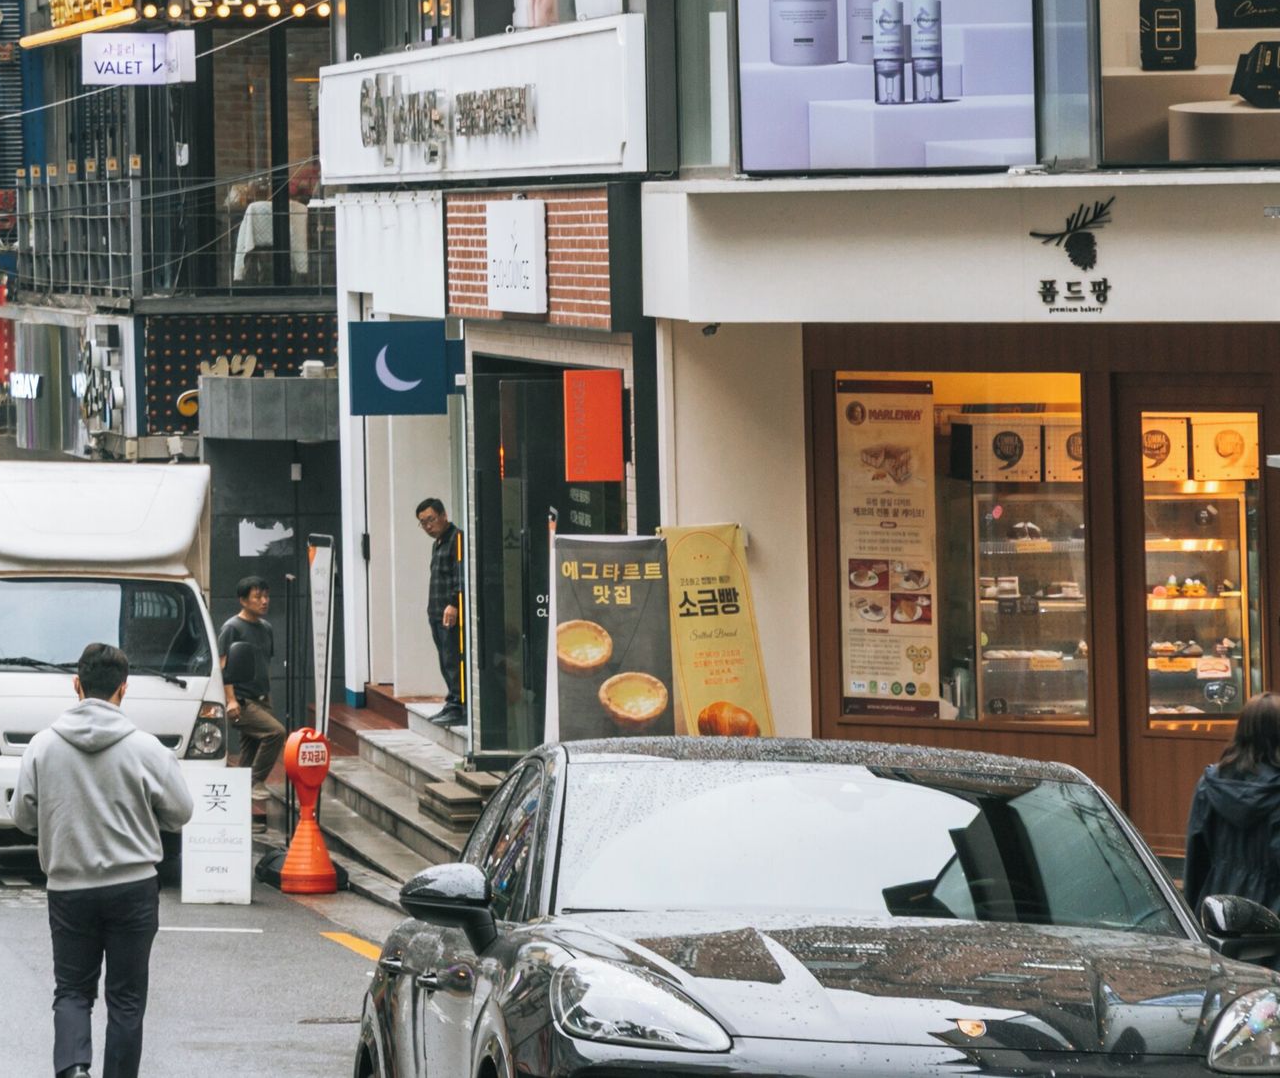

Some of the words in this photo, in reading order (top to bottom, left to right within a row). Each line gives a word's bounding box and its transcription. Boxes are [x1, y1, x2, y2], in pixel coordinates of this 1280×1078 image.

[94, 60, 143, 75] VALET
[1080, 306, 1103, 314] bakery
[868, 409, 923, 421] MARLENKA
[561, 560, 663, 581] 에그타르트
[593, 585, 632, 605] 맛집
[679, 586, 740, 618] 소금빵
[300, 750, 326, 764] 주차금지
[203, 783, 231, 813] 꽃
[205, 865, 228, 875] OPEN
